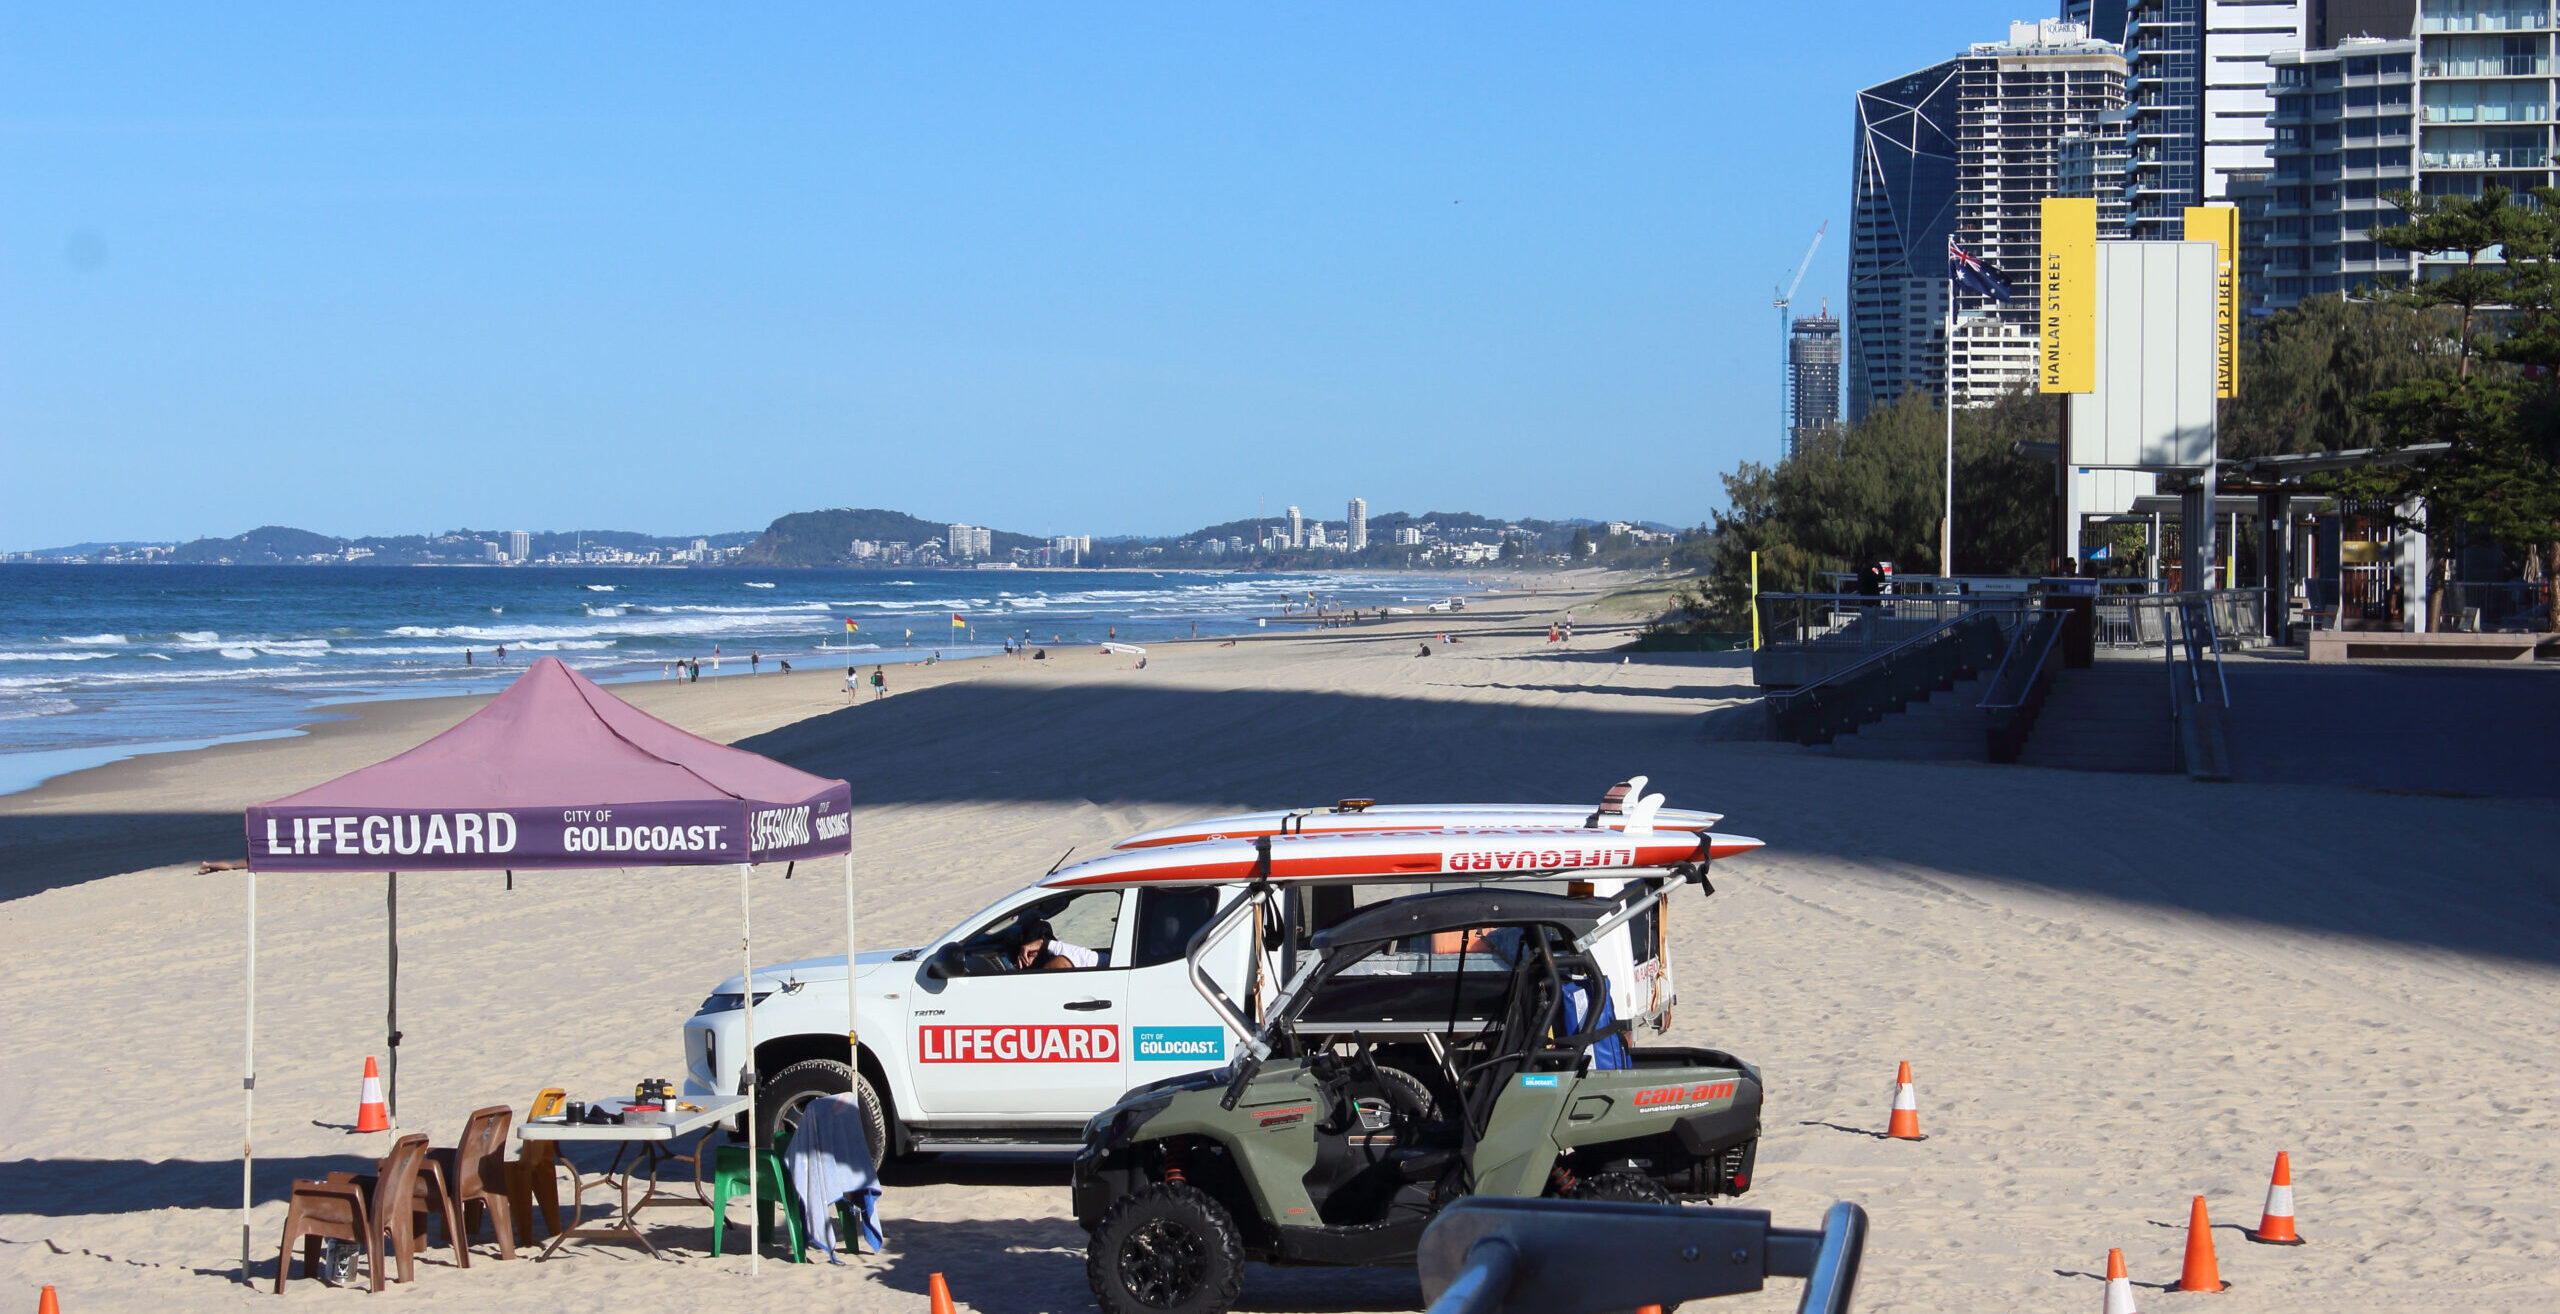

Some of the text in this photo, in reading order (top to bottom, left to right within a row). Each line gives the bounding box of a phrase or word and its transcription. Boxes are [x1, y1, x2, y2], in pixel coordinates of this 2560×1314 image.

[2048, 252, 2061, 385] HANLAN STREET
[563, 810, 612, 823] CITY OF
[750, 806, 810, 852] LIFEGUARD
[267, 812, 517, 856] LIFEGUARD
[1449, 849, 1632, 871] LIFEGUARD
[914, 1009, 946, 1017] TRITON
[924, 1028, 1117, 1060] LIFEGUARD
[1140, 1033, 1154, 1041] CITY
